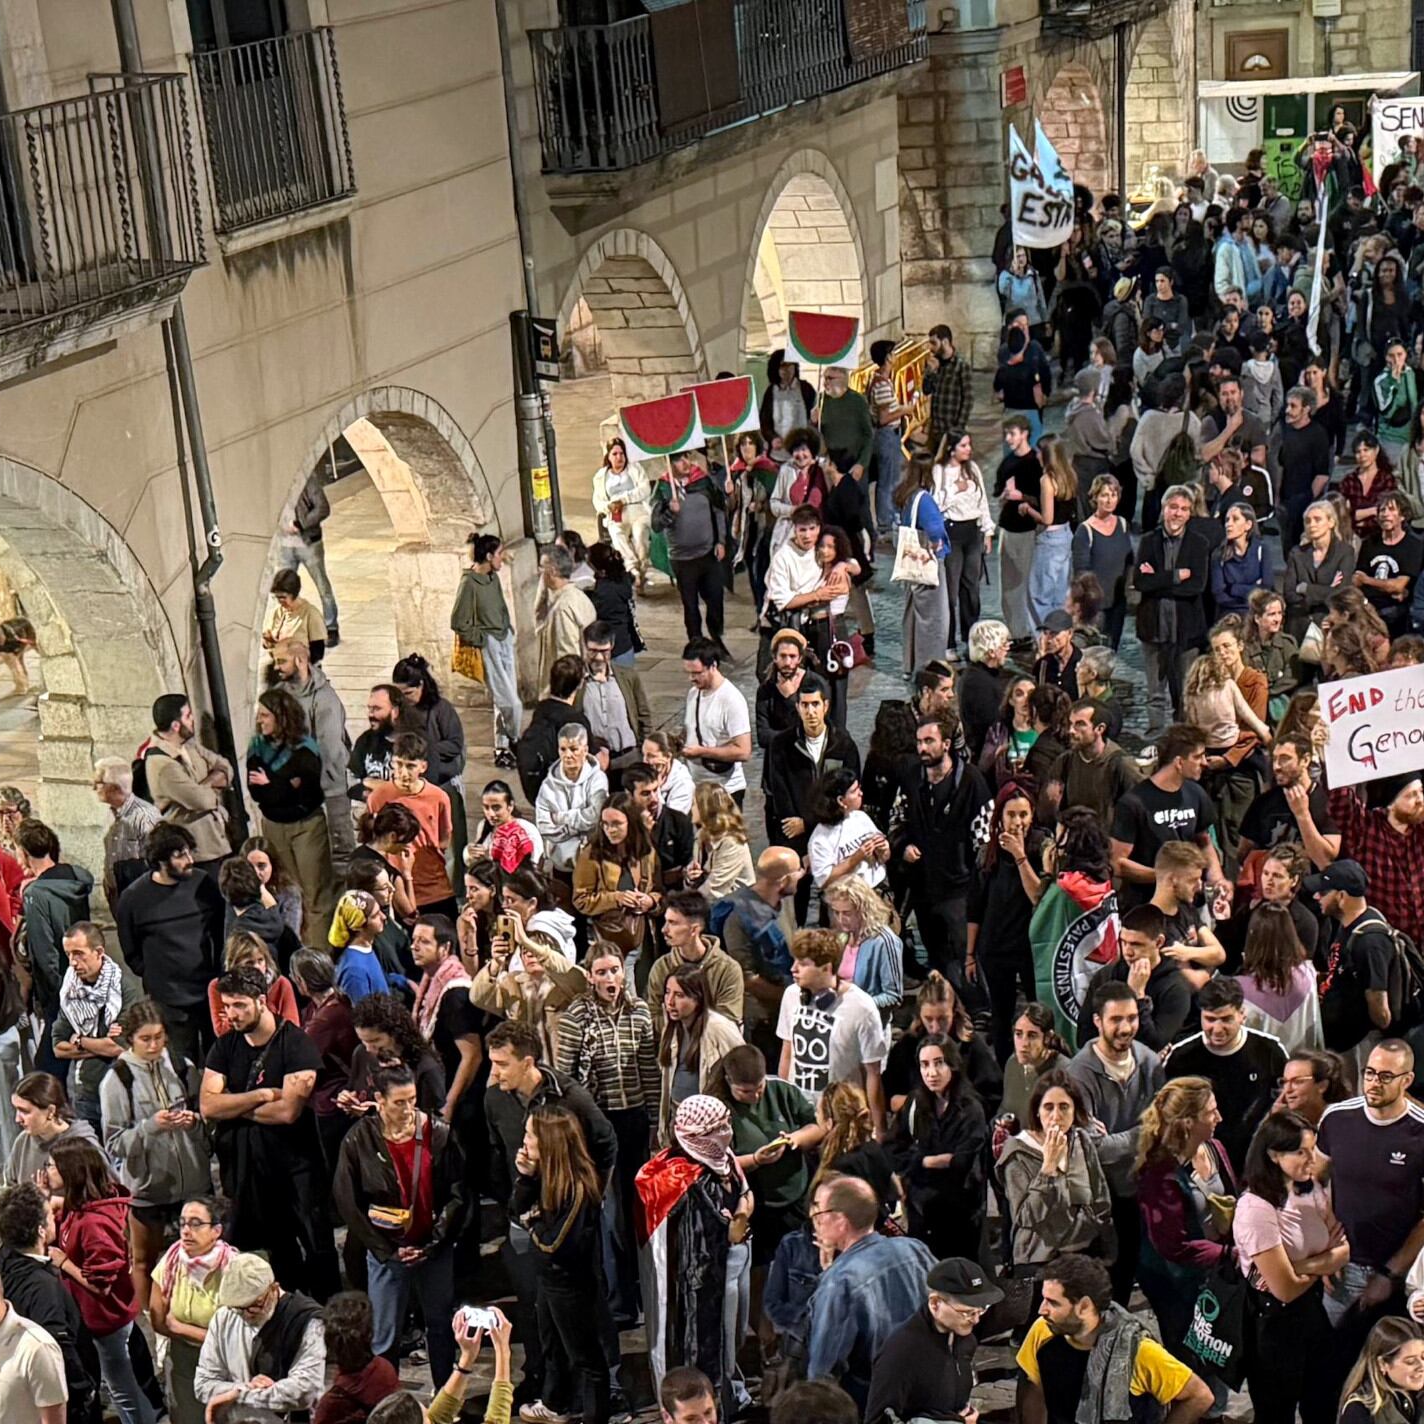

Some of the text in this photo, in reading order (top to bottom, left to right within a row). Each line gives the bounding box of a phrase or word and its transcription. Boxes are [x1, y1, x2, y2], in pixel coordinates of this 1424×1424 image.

[1328, 687, 1384, 722] END
[1056, 919, 1091, 996] PALESTINA
[795, 1033, 828, 1061] DO
